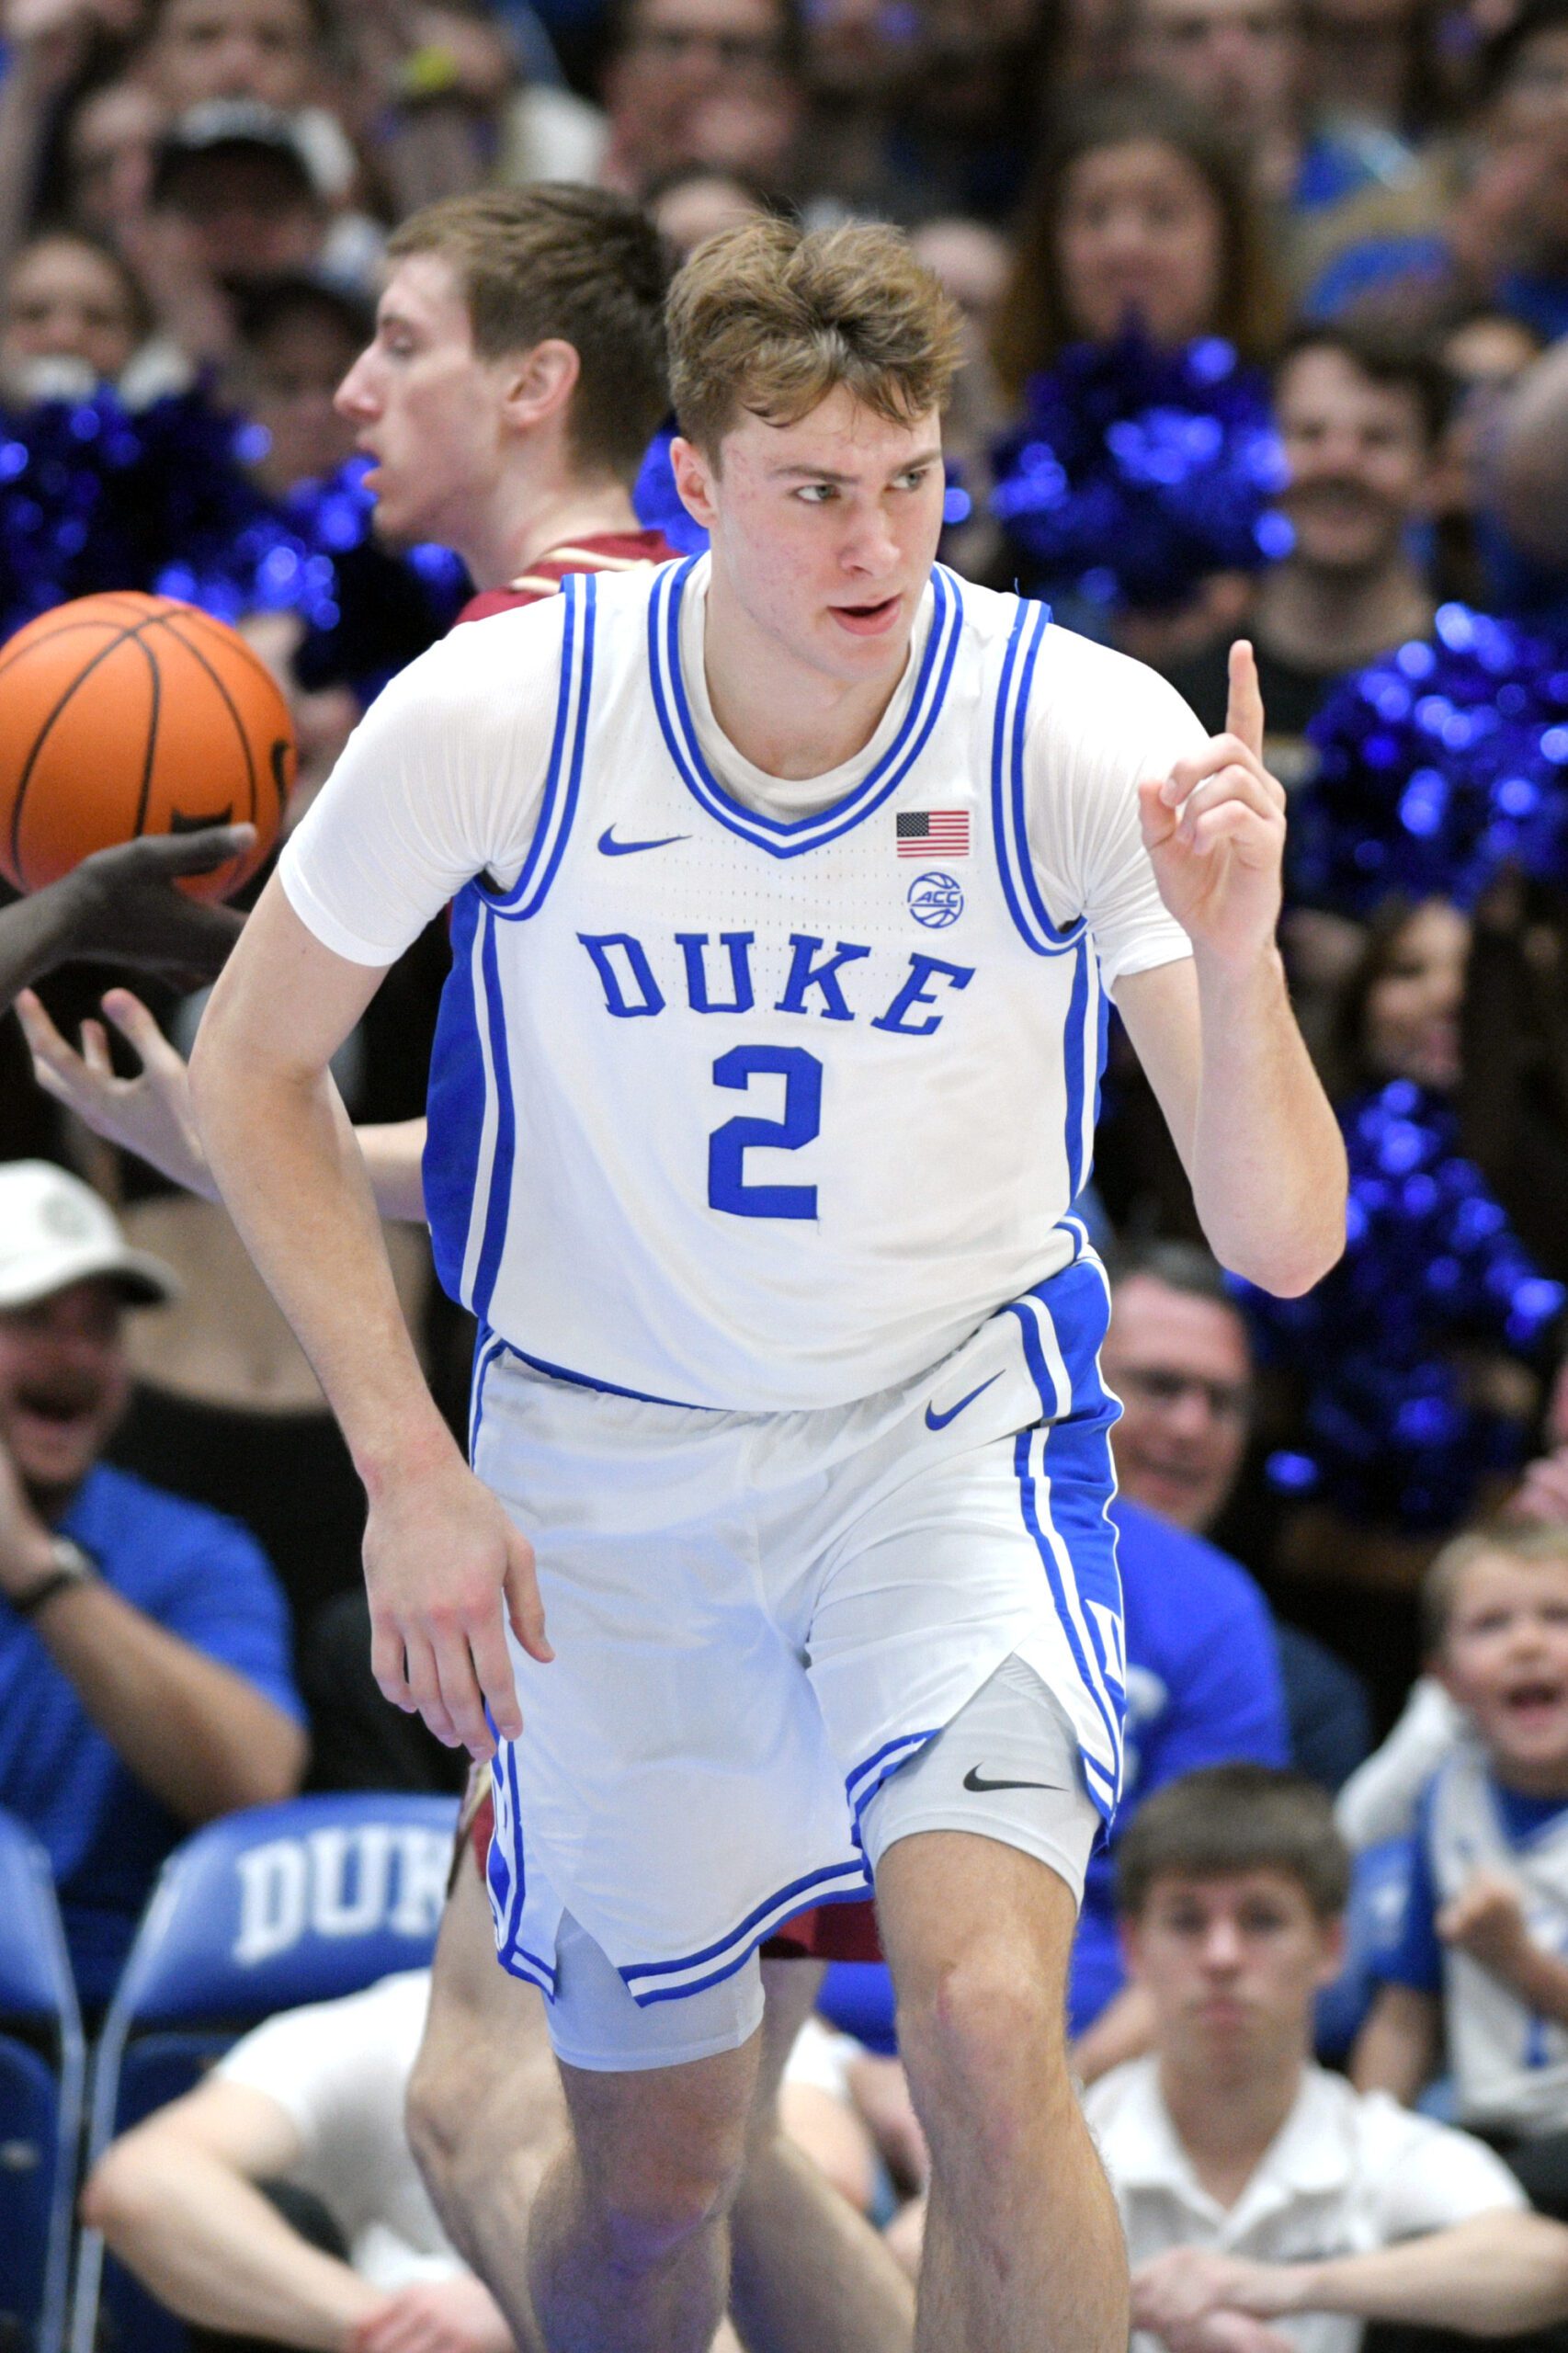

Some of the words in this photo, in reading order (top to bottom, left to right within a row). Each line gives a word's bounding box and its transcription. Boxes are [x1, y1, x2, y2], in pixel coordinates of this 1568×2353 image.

[915, 890, 960, 904] ACC
[575, 931, 976, 1036] DUKE
[708, 1044, 823, 1221] 2
[230, 1824, 454, 1967] DUK
